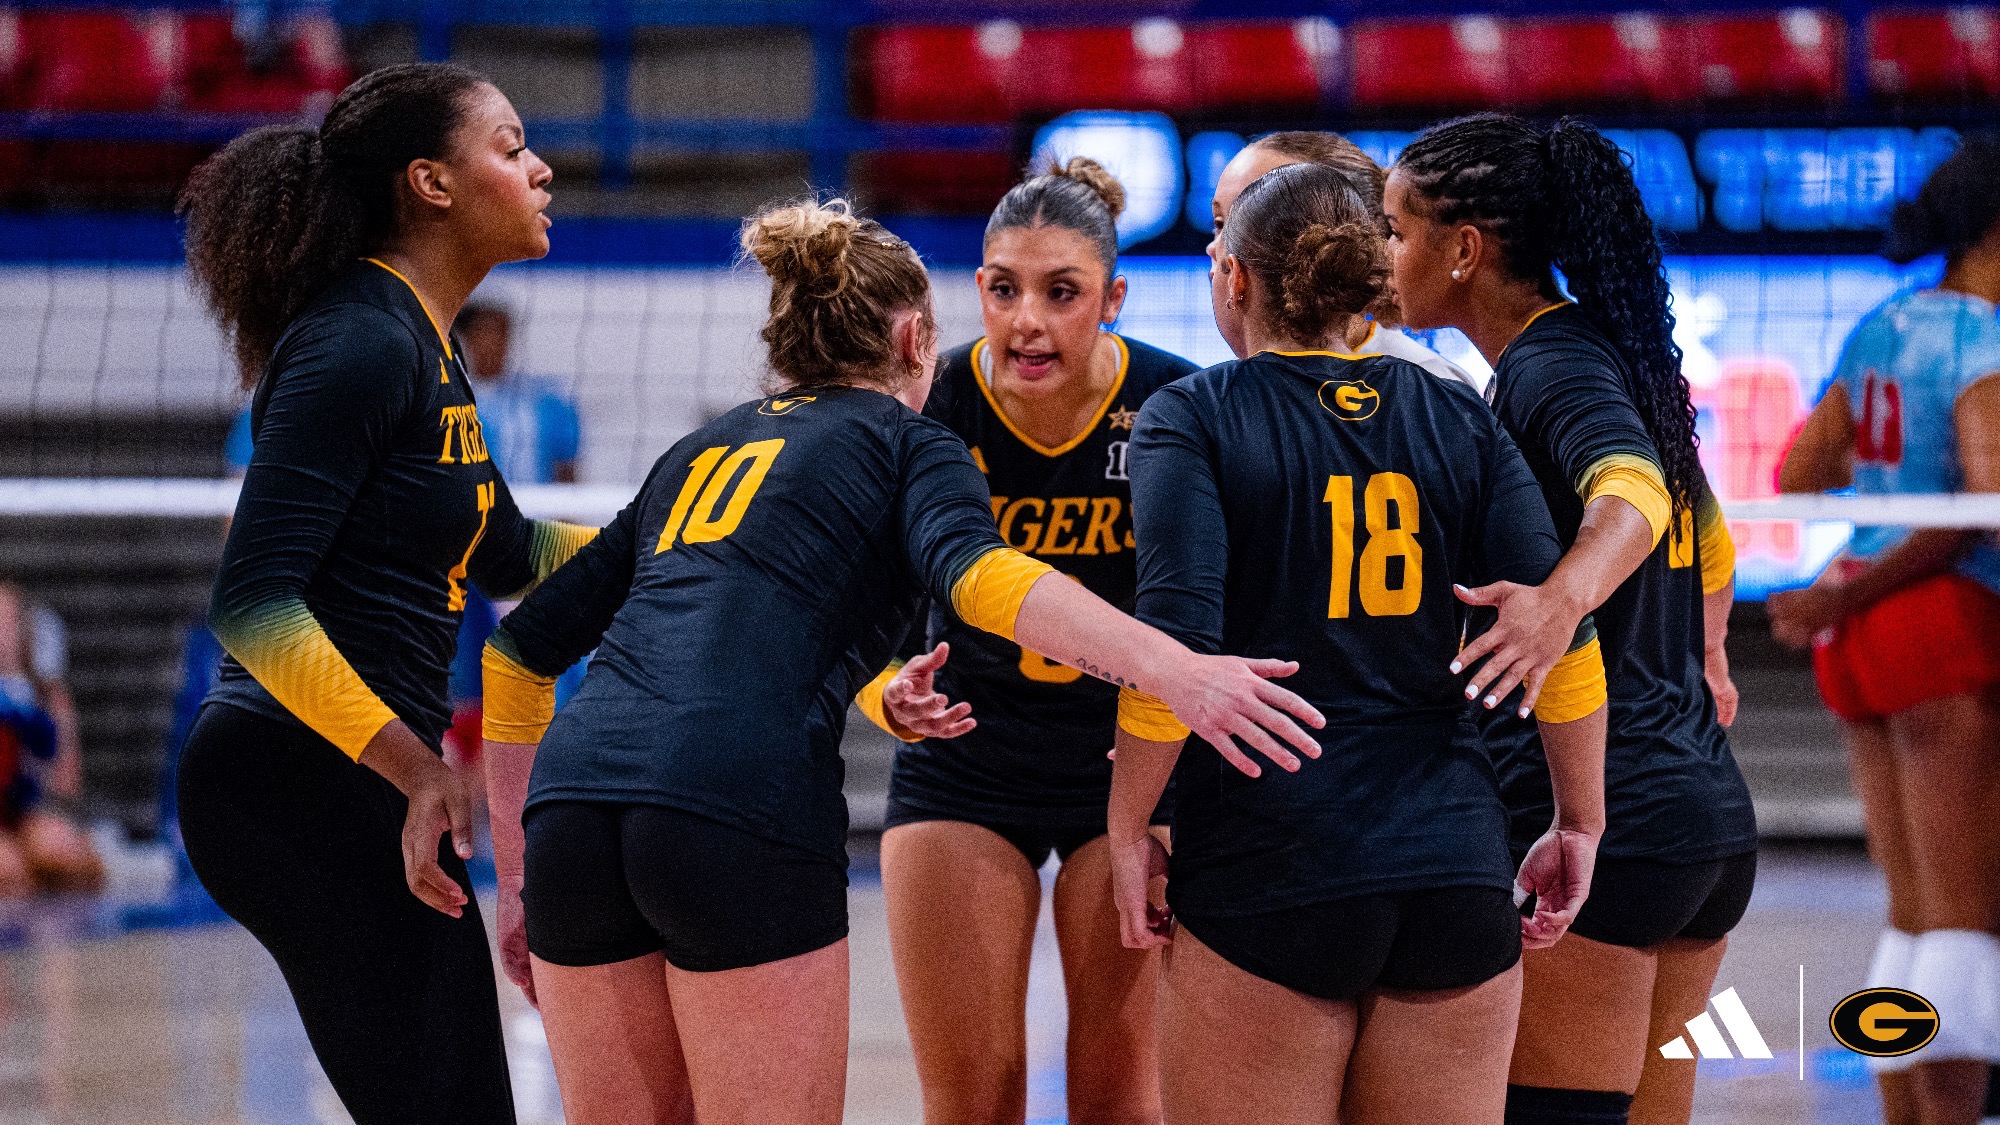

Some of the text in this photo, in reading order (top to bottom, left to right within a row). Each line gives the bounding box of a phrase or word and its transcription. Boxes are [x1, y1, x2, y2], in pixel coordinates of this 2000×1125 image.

[1335, 385, 1378, 411] G
[654, 438, 786, 556] 10
[1322, 471, 1423, 619] 18
